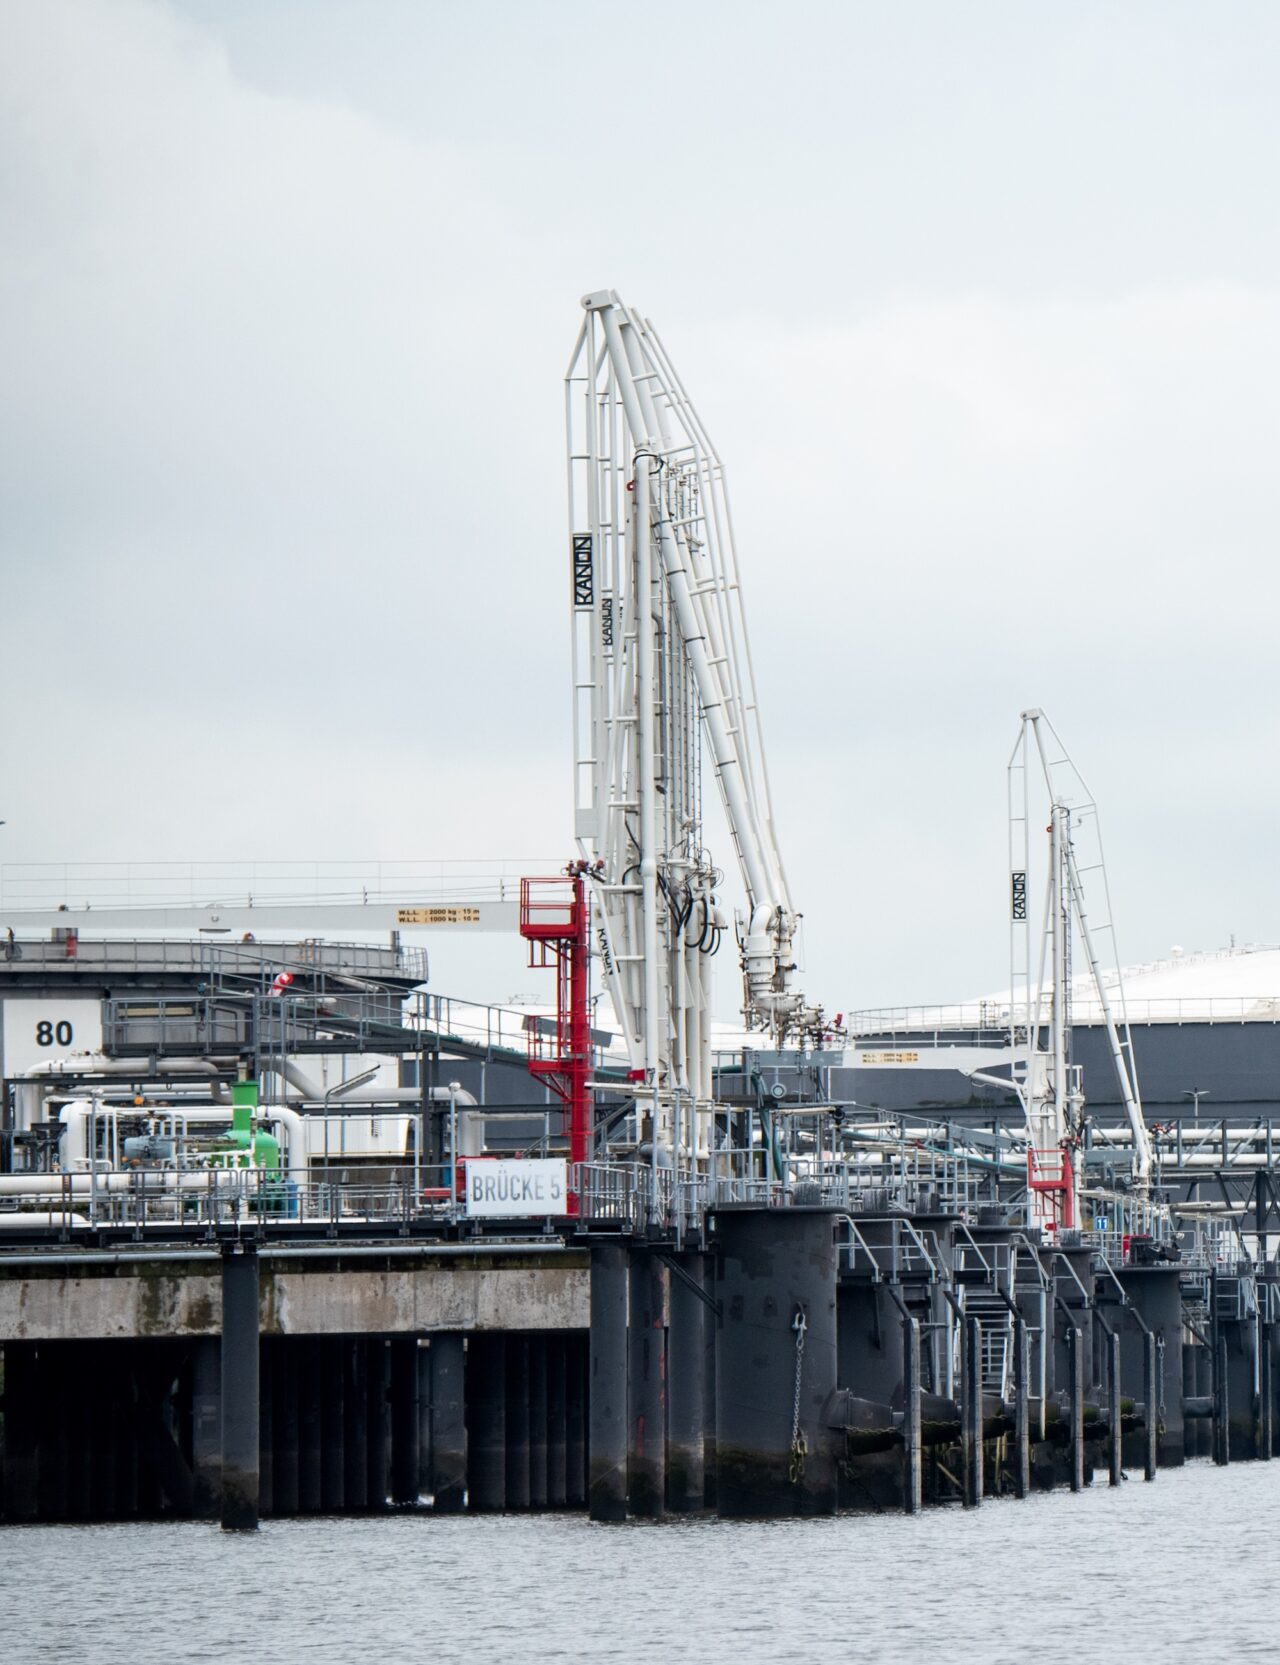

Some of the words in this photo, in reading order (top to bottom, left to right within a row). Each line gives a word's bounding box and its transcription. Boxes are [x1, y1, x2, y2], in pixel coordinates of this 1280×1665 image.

[574, 536, 593, 605] KANON
[1012, 872, 1026, 919] KANON
[36, 1020, 73, 1047] 80
[473, 1170, 544, 1202] BRÜCKE
[550, 1174, 560, 1200] 5
[1097, 1218, 1108, 1230] 11
